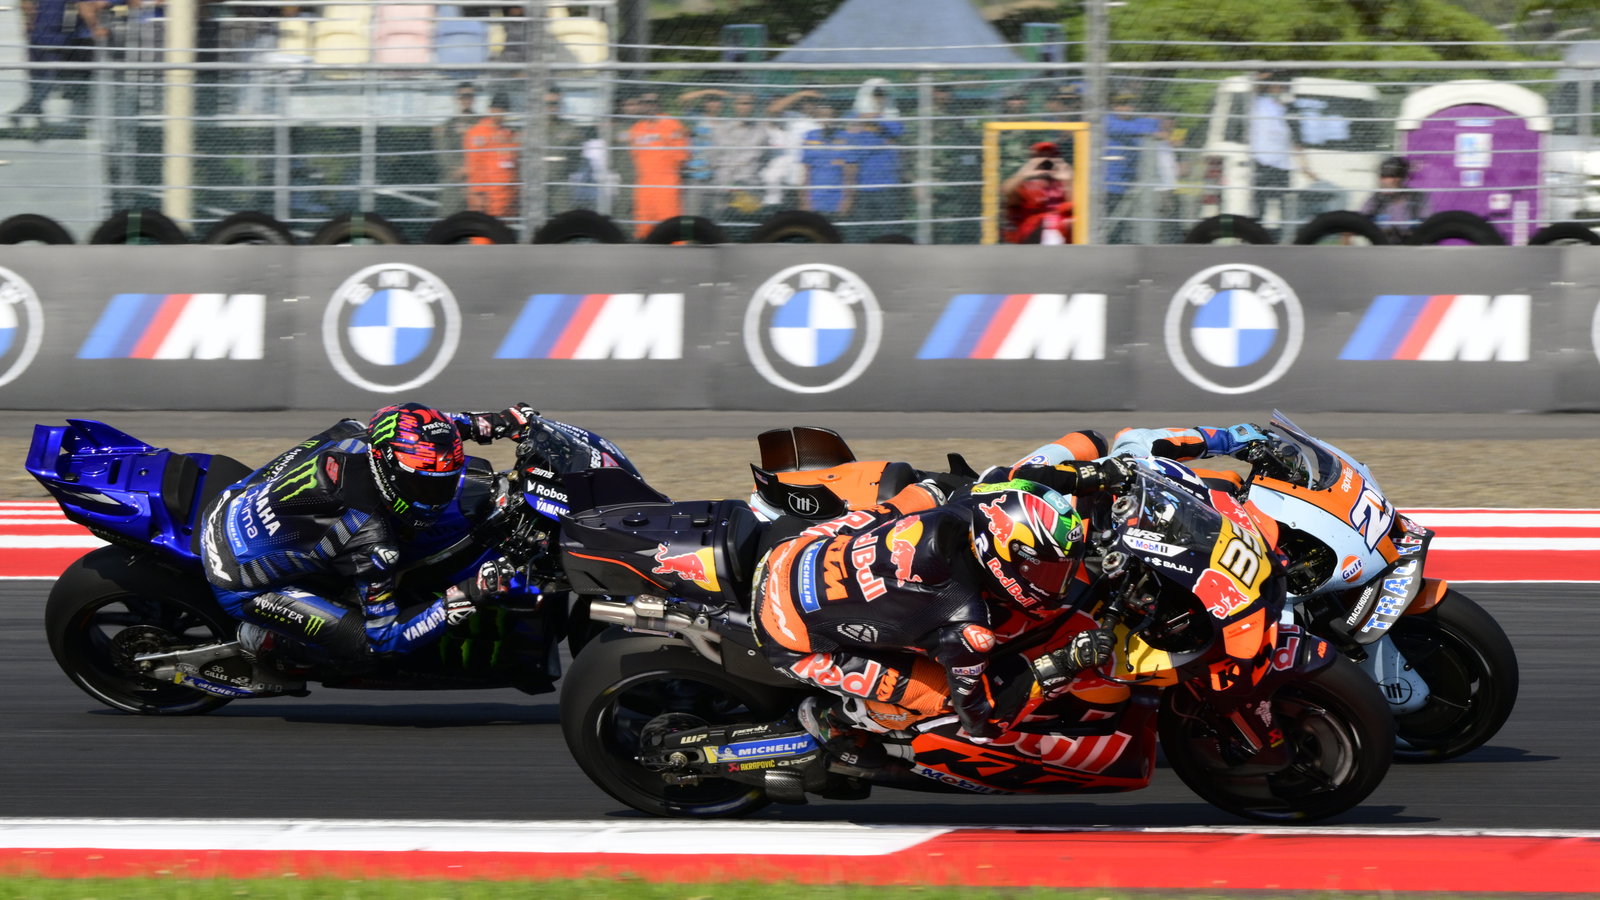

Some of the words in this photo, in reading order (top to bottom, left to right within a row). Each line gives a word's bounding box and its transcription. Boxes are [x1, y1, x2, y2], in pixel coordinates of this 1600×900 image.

[802, 552, 814, 604] MICHELIN
[1162, 560, 1194, 575] BAJAJ
[1341, 559, 1363, 581] Gulf
[1346, 586, 1374, 627] TRACKHOUSE
[876, 668, 900, 702] KTM
[738, 741, 808, 757] MICHELIN
